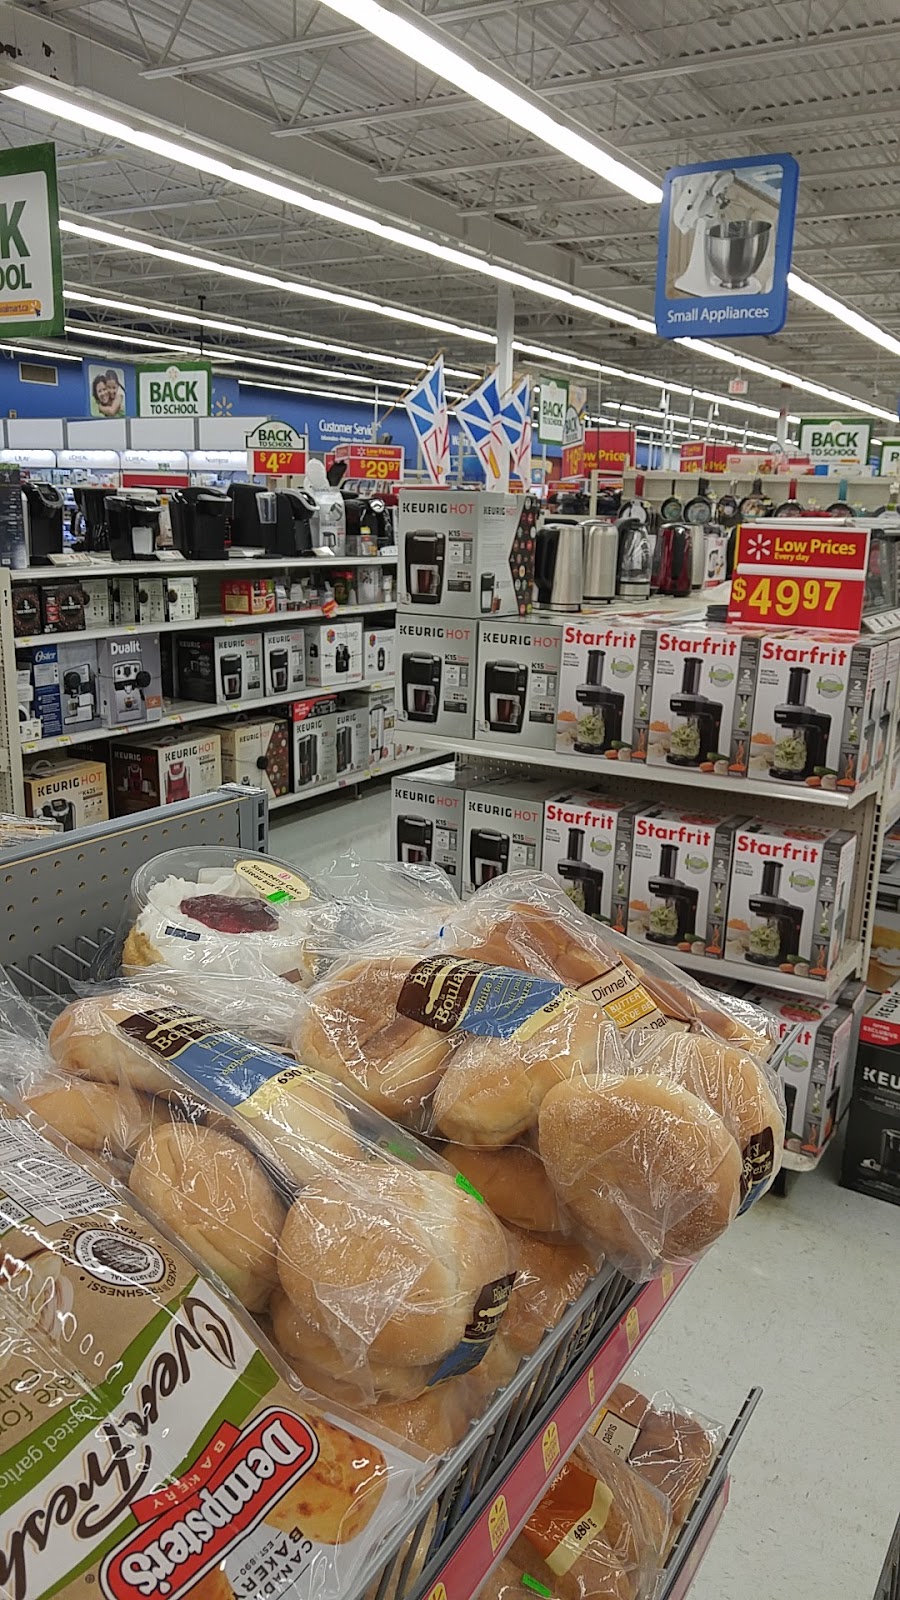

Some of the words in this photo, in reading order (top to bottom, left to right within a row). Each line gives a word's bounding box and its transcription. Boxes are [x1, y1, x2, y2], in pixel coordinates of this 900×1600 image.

[667, 309, 699, 324] Small
[700, 305, 769, 323] Appliances
[150, 380, 199, 403] BACK
[150, 404, 162, 414] TO
[163, 404, 199, 415] SCHOOL
[543, 400, 563, 418] BACK
[258, 429, 292, 442] BACK
[319, 419, 353, 434] Customer
[354, 422, 374, 436] Servic
[267, 440, 293, 448] SCHOOL
[811, 432, 859, 448] BACK
[584, 452, 596, 461] ow
[823, 448, 858, 457] SCHOOL
[402, 502, 448, 513] KEURIG
[449, 503, 475, 514] HOT
[774, 537, 807, 553] Low
[810, 538, 857, 556] Prices
[774, 554, 795, 562] Every
[796, 553, 810, 564] day
[268, 635, 291, 645] KEURIG
[400, 624, 444, 639] KEURIG
[446, 629, 471, 641] HOT
[483, 632, 531, 647] KEURIG
[533, 636, 561, 649] HOT
[564, 626, 637, 649] Starfrit
[110, 640, 142, 656] Dualit
[219, 640, 245, 649] KEURIG
[658, 633, 737, 656] Starfrit
[35, 650, 56, 663] Oster
[762, 641, 847, 666] Starfrit
[642, 660, 649, 670] 2
[743, 669, 751, 679] 2
[854, 680, 862, 690] 2
[296, 720, 322, 734] KEURIG
[337, 713, 357, 725] EURIG
[239, 732, 260, 743] KEURIG
[114, 751, 142, 762] KEURIG
[165, 746, 198, 763] KEURIG
[199, 741, 215, 754] HOT
[37, 777, 80, 798] KEURIG
[80, 772, 103, 786] HOT
[395, 788, 436, 804] KEURIG
[436, 795, 460, 808] HOT
[469, 801, 512, 818] KEURIG
[513, 808, 539, 822] HOT
[546, 804, 614, 831] Starfrit
[636, 819, 711, 847] Starfrit
[619, 842, 626, 851] 2
[737, 834, 819, 864] Starfrit
[717, 859, 724, 868] 2
[250, 864, 287, 888] Strawberry
[285, 883, 302, 895] Cake
[825, 876, 832, 886] 2
[591, 975, 629, 1002] Dinner
[609, 992, 642, 1014] BUTTER
[817, 1060, 825, 1070] 2
[277, 1068, 302, 1086] 690
[863, 1066, 900, 1089] KEU
[161, 1252, 177, 1288] LOCKED
[42, 1399, 100, 1453] roasted
[603, 1422, 618, 1446] pains
[153, 1438, 226, 1510] BAKERY
[118, 1415, 308, 1598] Dempster's
